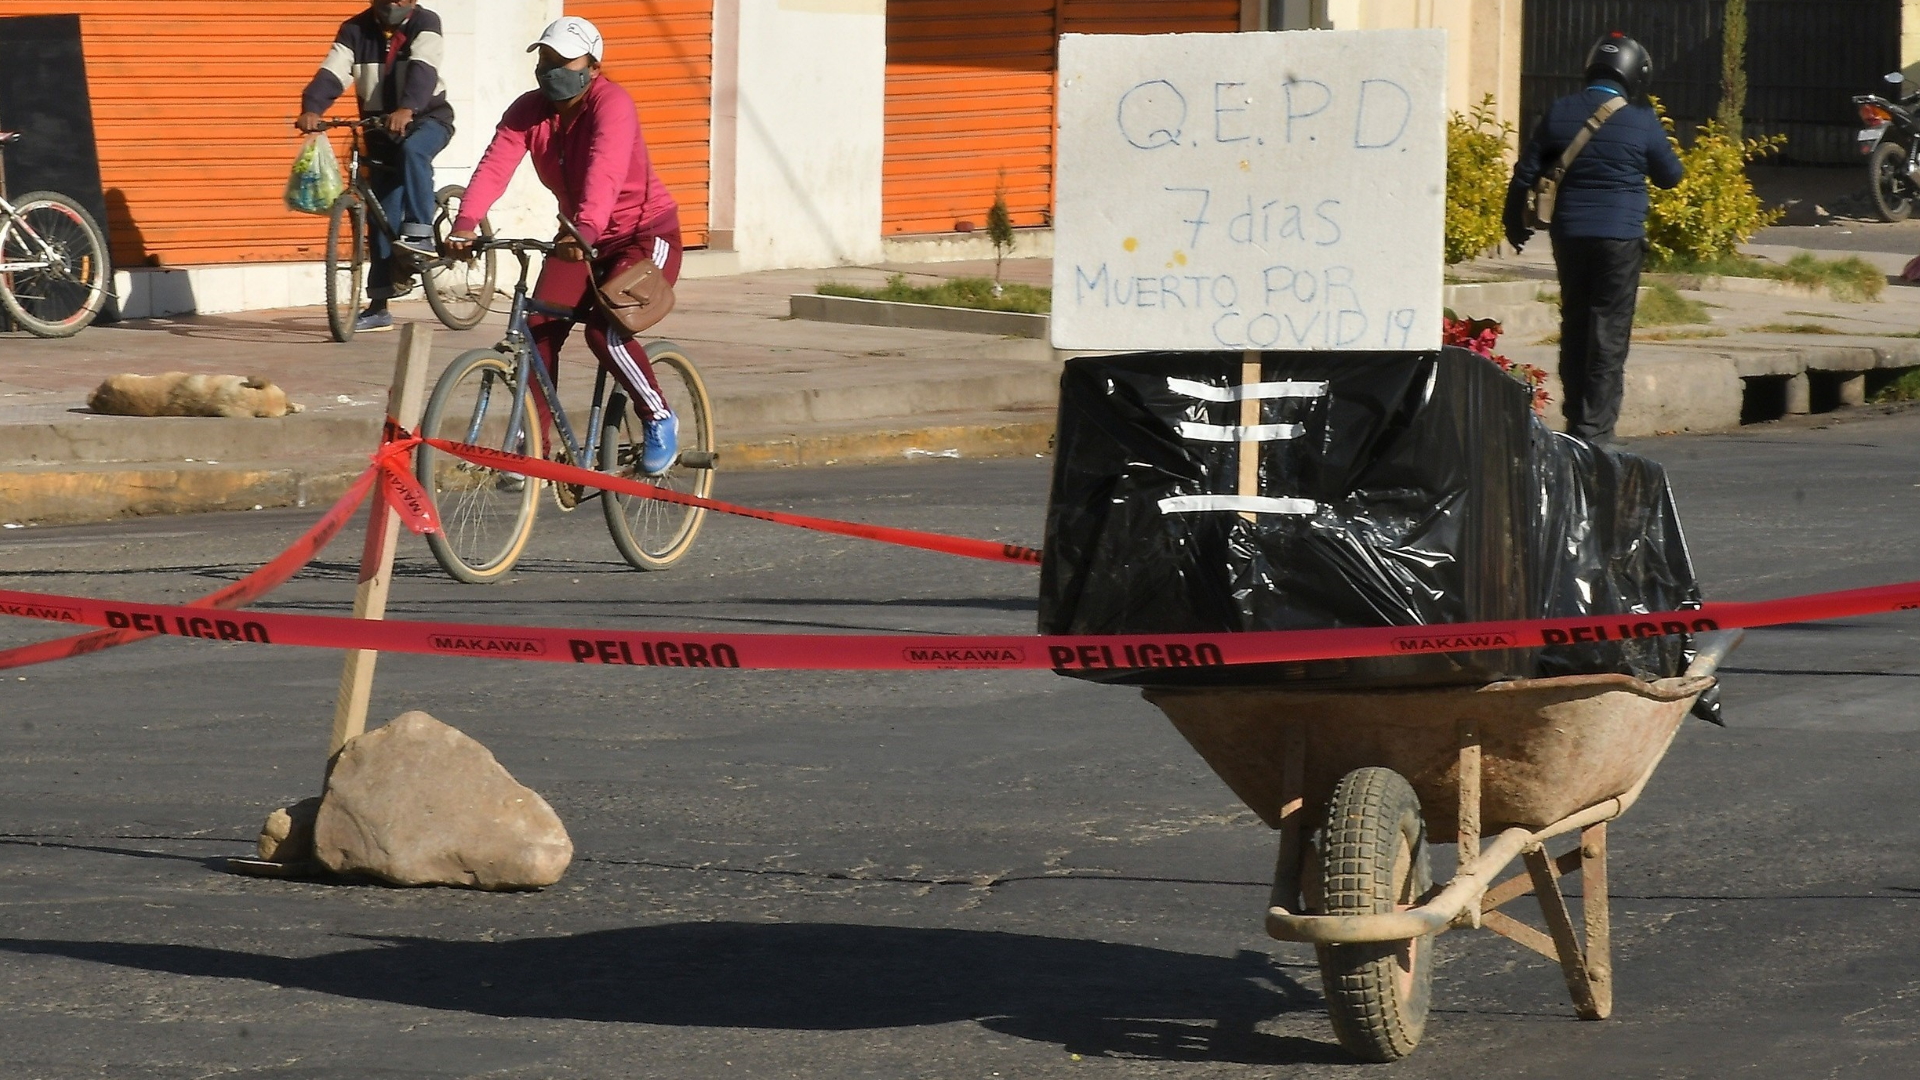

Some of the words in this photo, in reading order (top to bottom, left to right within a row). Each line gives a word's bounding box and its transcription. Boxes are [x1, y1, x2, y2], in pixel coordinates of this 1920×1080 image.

[1164, 187, 1210, 249] 7
[1228, 195, 1342, 247] días
[1075, 262, 1239, 310] MUERTO
[1263, 265, 1362, 313] POR
[1212, 309, 1369, 349] COVID
[1384, 308, 1416, 349] 19
[385, 467, 422, 513] MAKAW
[0, 604, 76, 621] AKAWA
[435, 637, 539, 653] MAKAWA
[568, 639, 740, 669] PELIGRO
[910, 649, 1017, 662] MAKAWA
[1047, 643, 1226, 669] PELIGRO
[1399, 636, 1509, 651] MAKAWA
